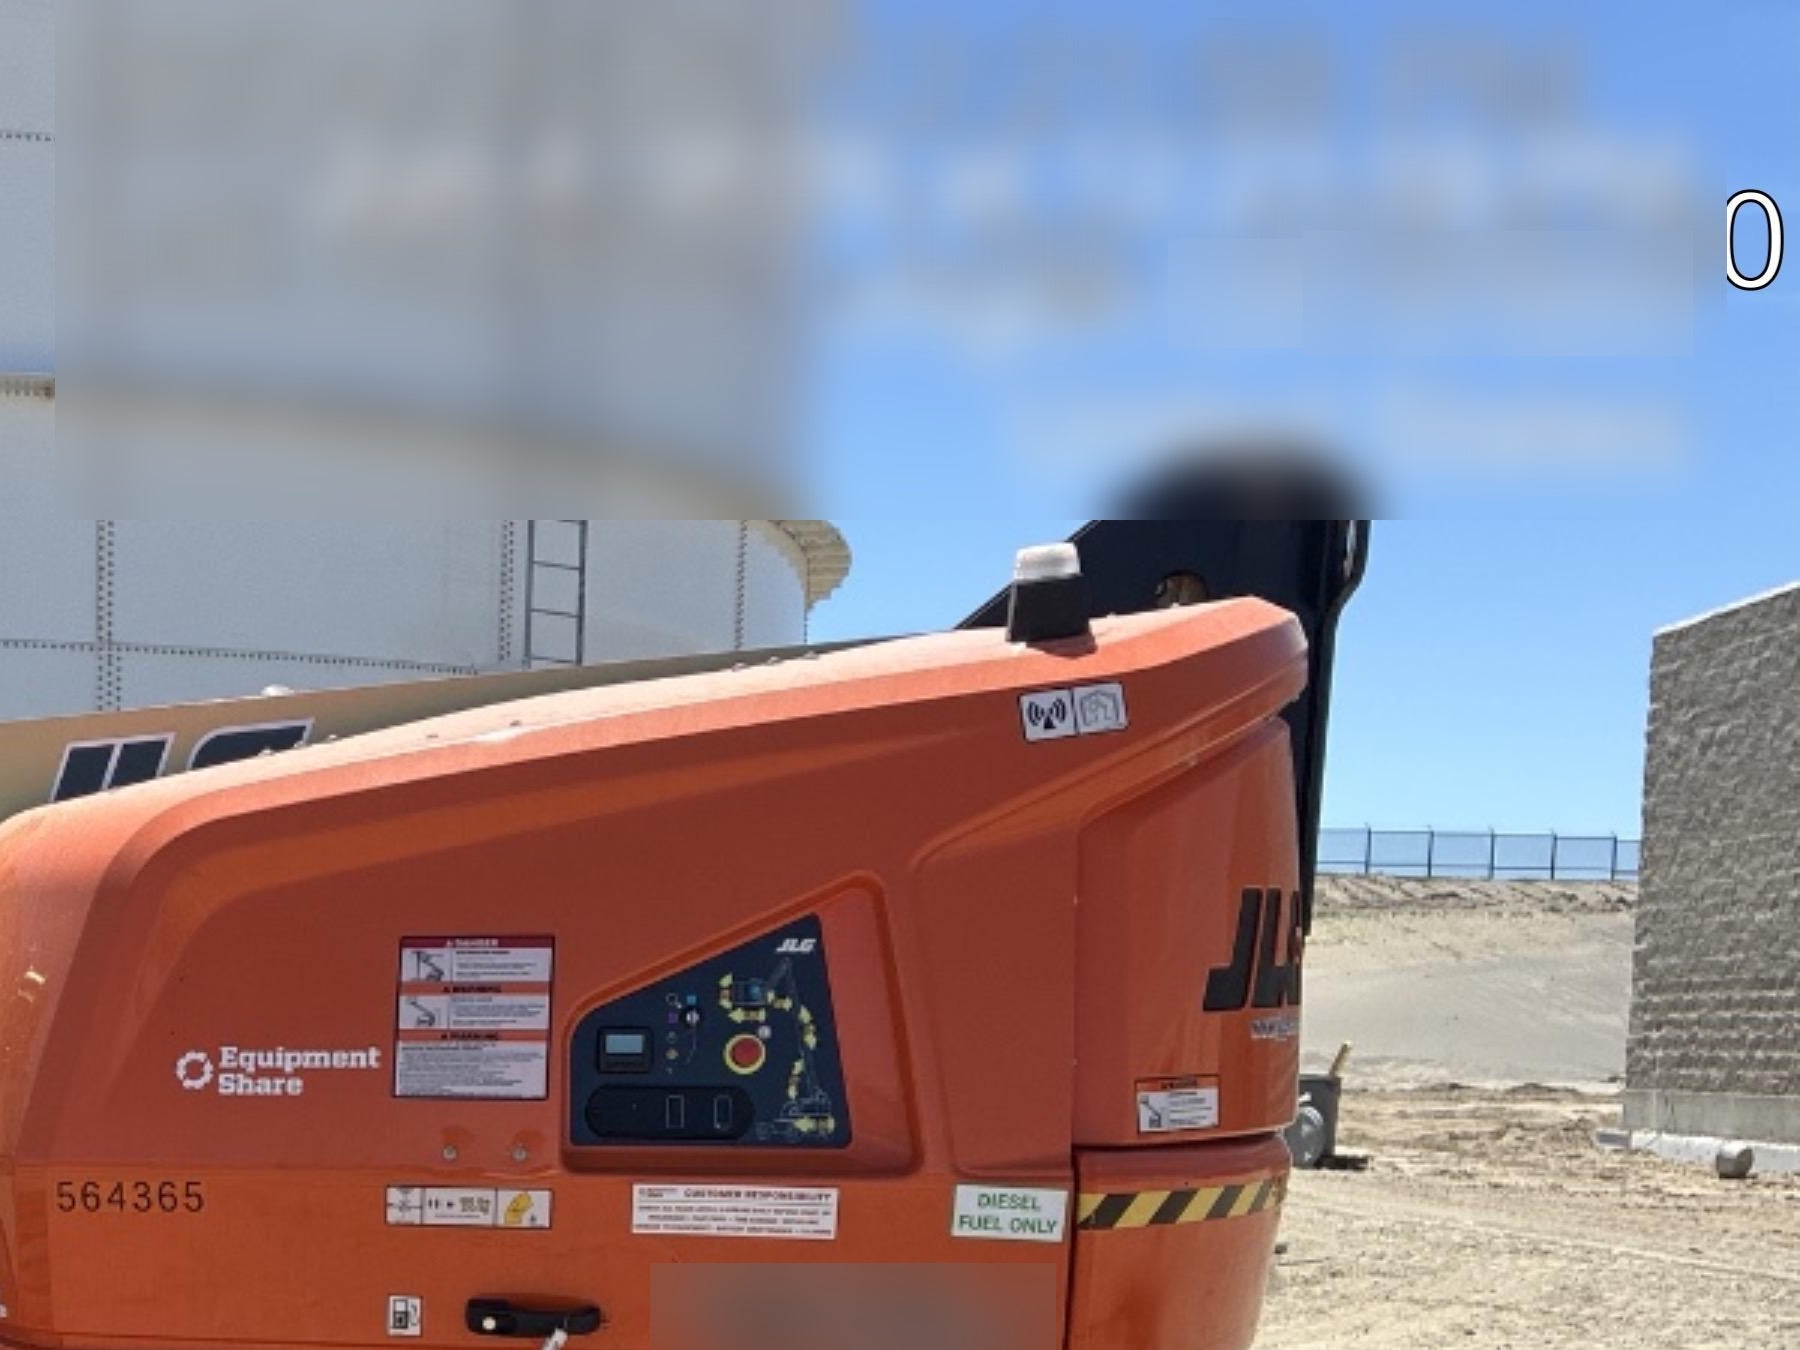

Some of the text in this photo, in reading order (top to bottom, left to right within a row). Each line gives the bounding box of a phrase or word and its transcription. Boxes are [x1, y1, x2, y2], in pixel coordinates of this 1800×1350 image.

[776, 938, 817, 953] JLG
[218, 1046, 382, 1073] Equipment
[218, 1073, 304, 1096] Share
[56, 1181, 204, 1213] 564365
[977, 1193, 1040, 1212] DIESEL
[958, 1214, 1057, 1234] FUEL ONLY
